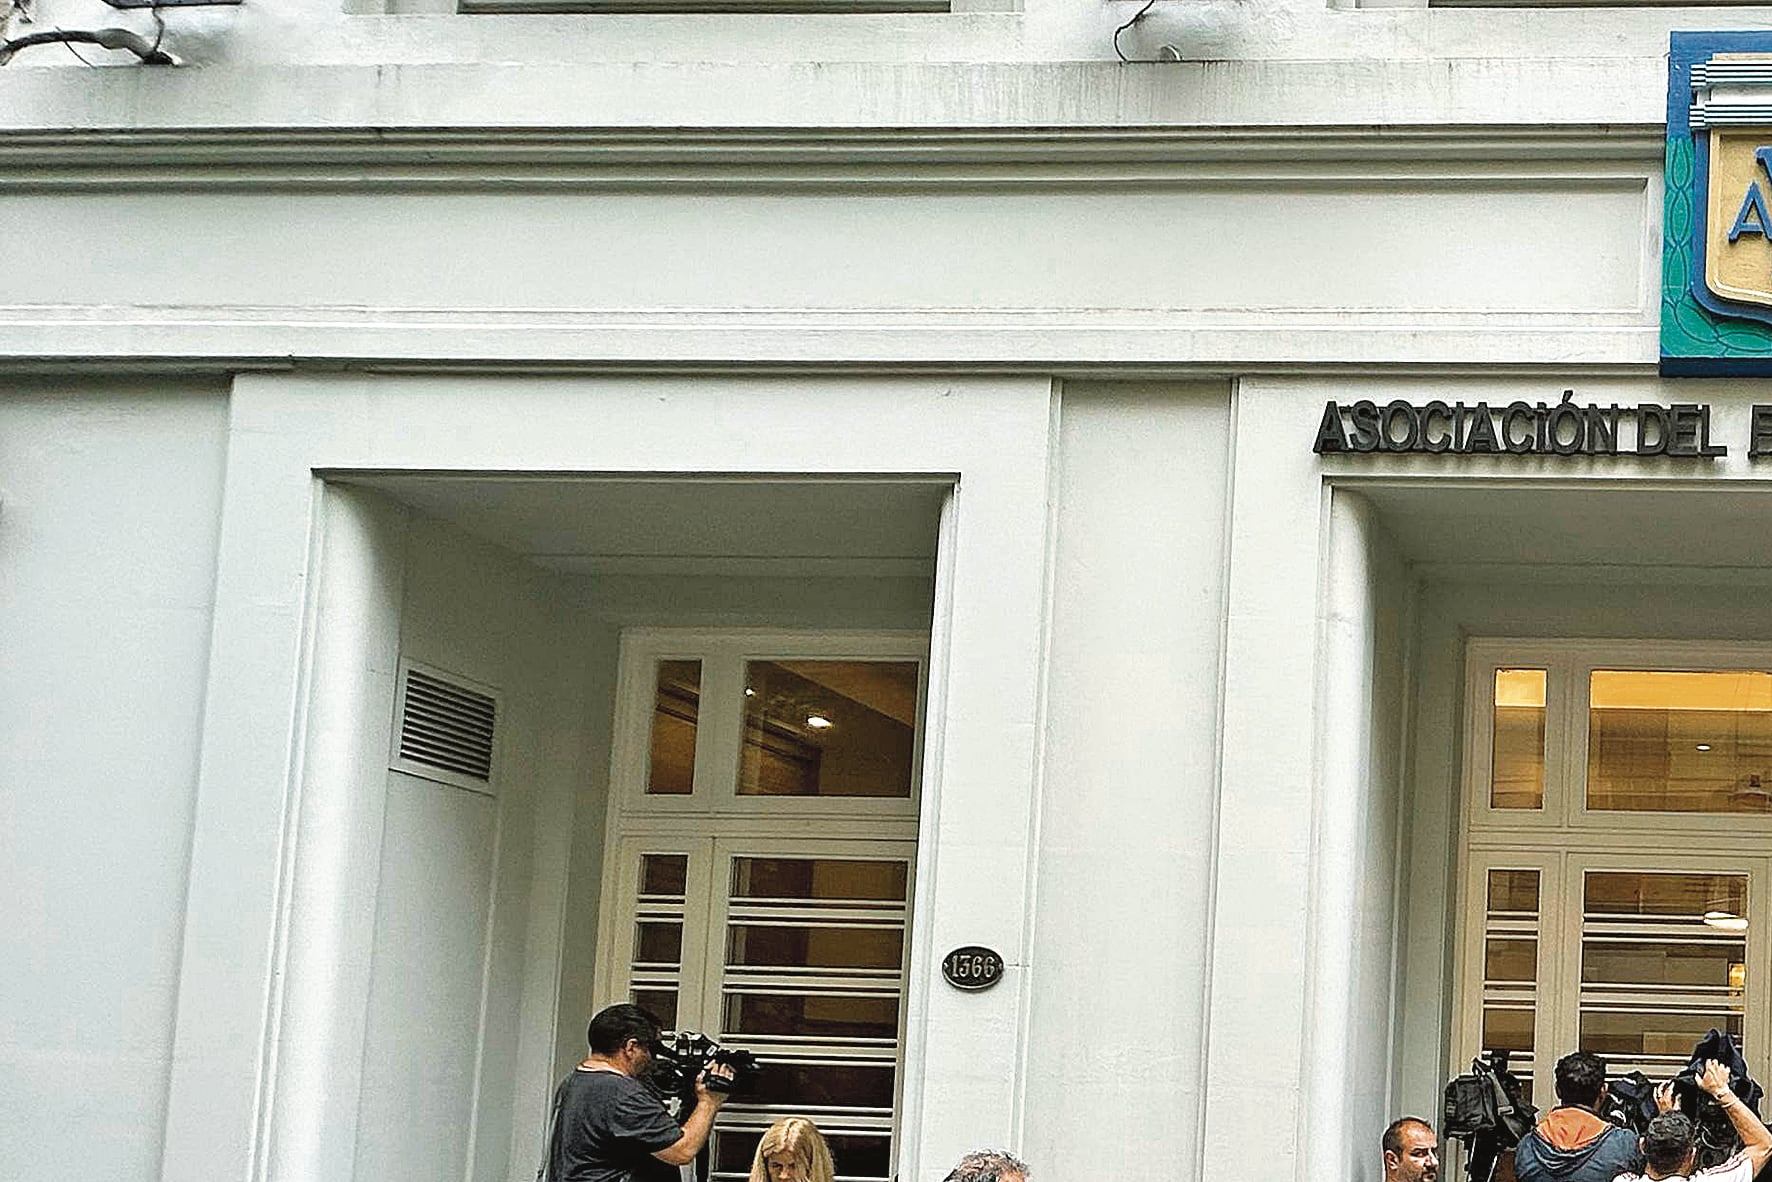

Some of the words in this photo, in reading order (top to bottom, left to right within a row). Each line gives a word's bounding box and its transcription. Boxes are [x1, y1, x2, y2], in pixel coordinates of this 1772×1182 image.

[1313, 391, 1618, 455] ASOCIACIÓN
[1637, 403, 1728, 458] DEL
[951, 954, 996, 978] 1366
